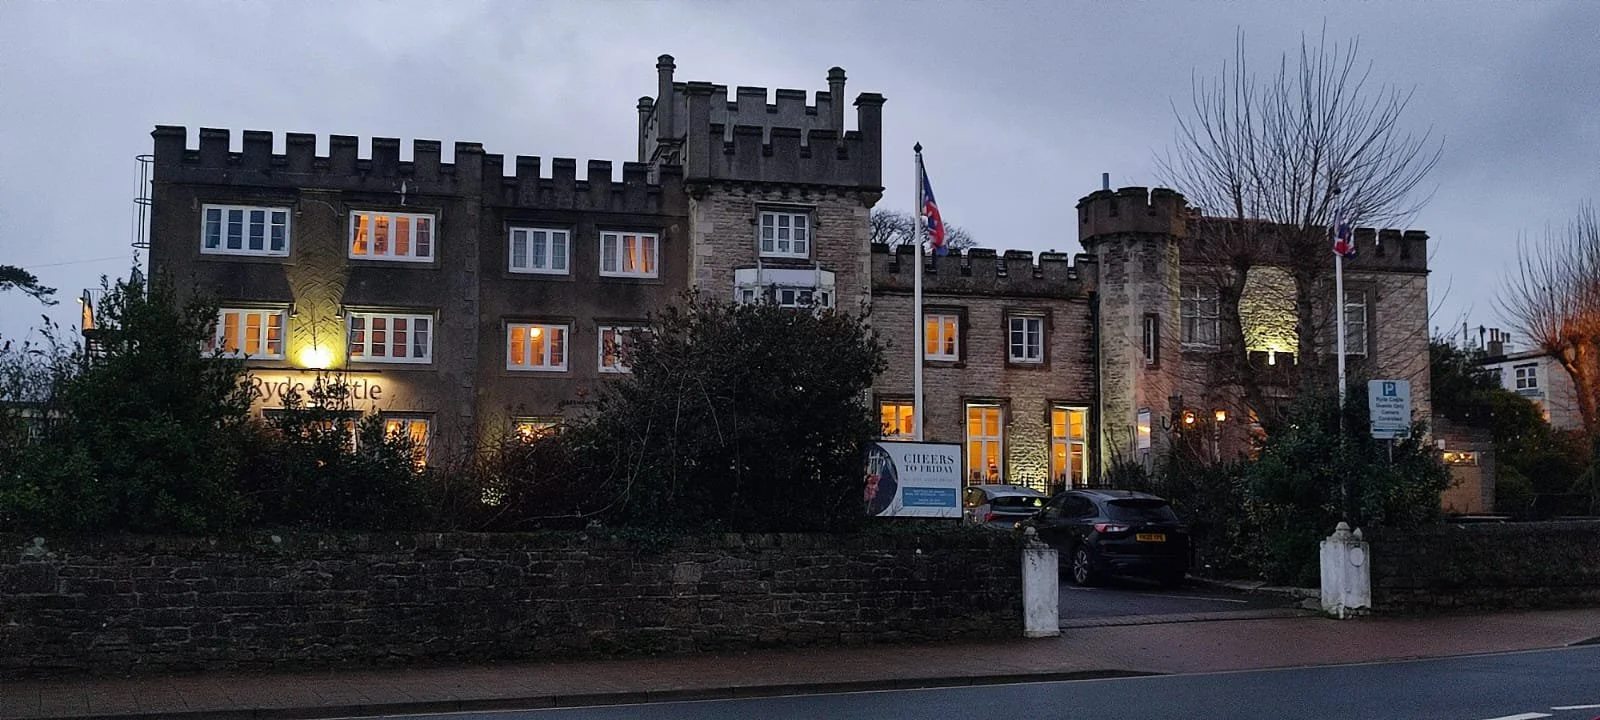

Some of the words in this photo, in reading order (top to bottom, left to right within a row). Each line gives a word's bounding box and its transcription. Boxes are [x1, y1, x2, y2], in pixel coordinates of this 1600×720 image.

[251, 376, 305, 402] Ryde
[904, 454, 954, 464] CHEERS
[920, 465, 953, 473] FRIDAY
